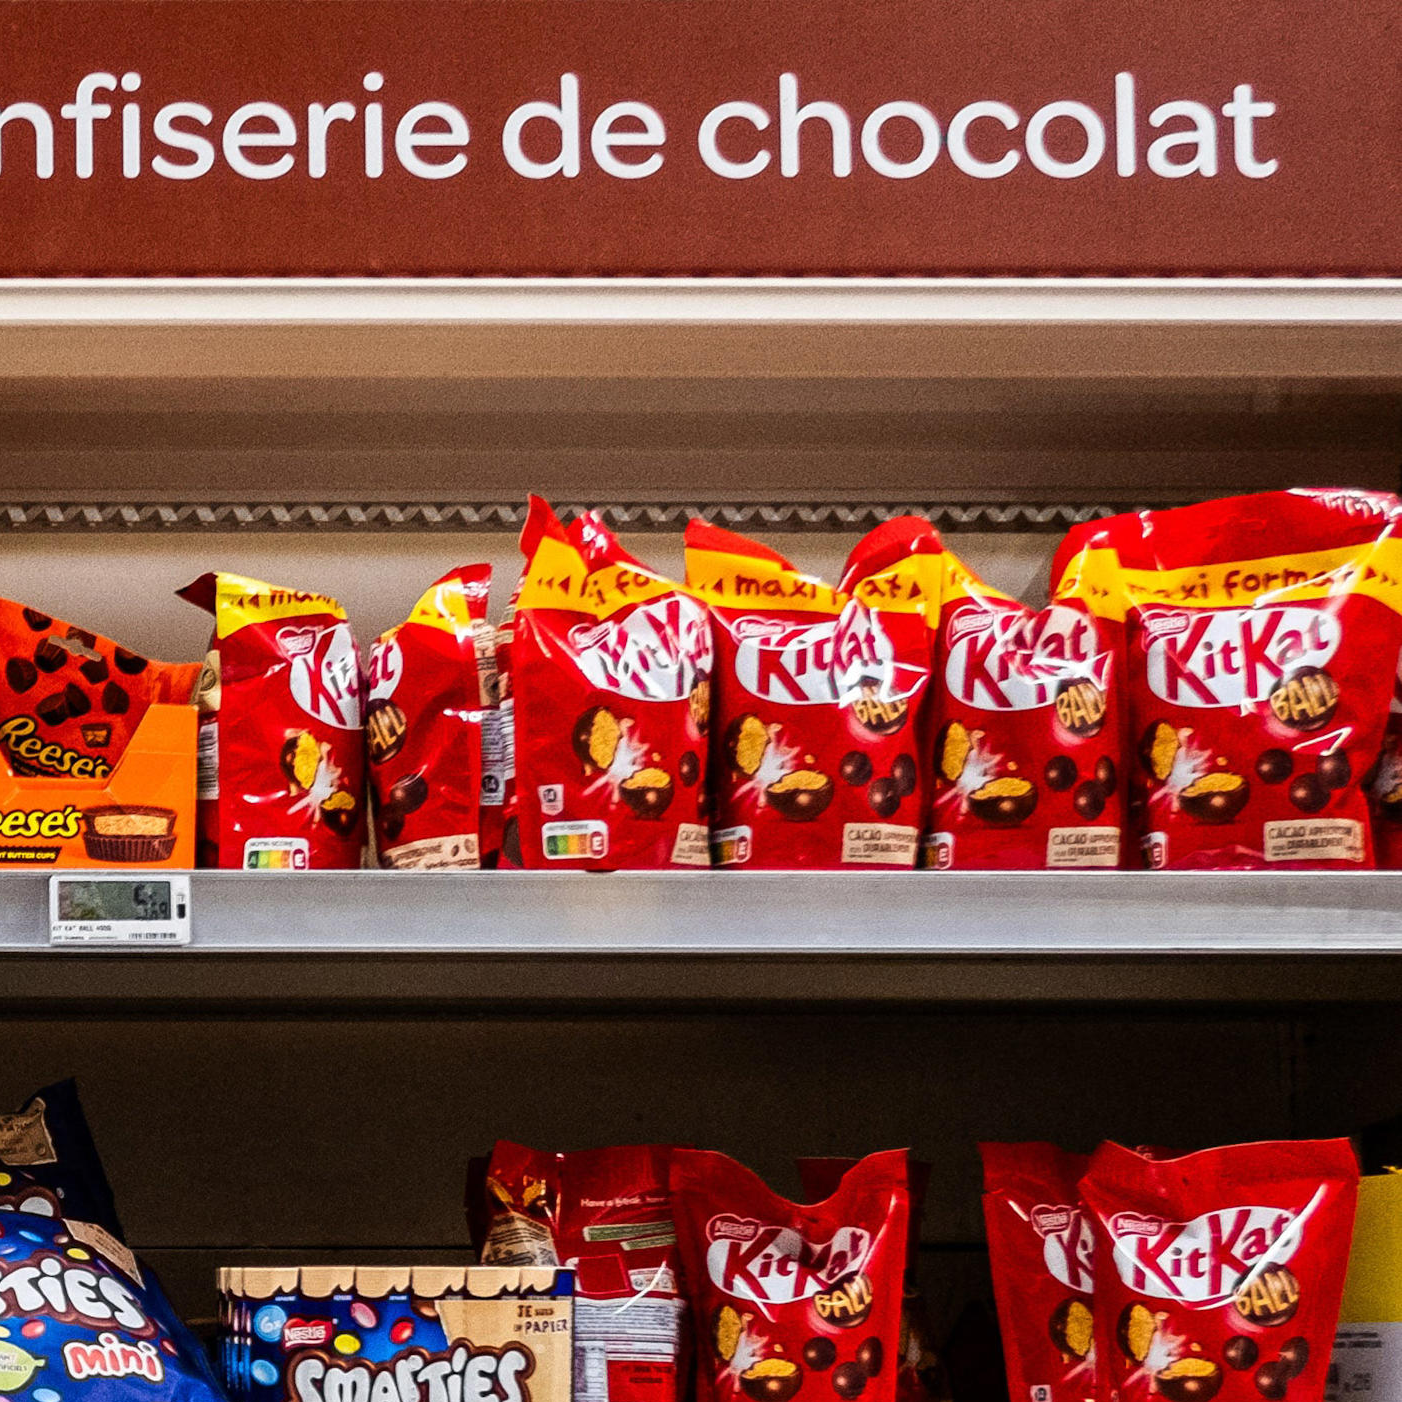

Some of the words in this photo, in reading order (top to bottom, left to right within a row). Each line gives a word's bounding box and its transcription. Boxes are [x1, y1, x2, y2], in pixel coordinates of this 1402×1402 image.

[501, 71, 665, 180] de
[697, 71, 1278, 180] chocolat
[733, 574, 820, 600] maxi
[1161, 608, 1333, 706] KitKat
[1271, 673, 1340, 725] BALL
[1131, 1207, 1292, 1303] KitKat
[517, 1305, 532, 1318] JE
[815, 1280, 872, 1318] BALL
[1236, 1277, 1300, 1315] BALL
[524, 1318, 570, 1334] PAPIER
[65, 1332, 164, 1382] mini
